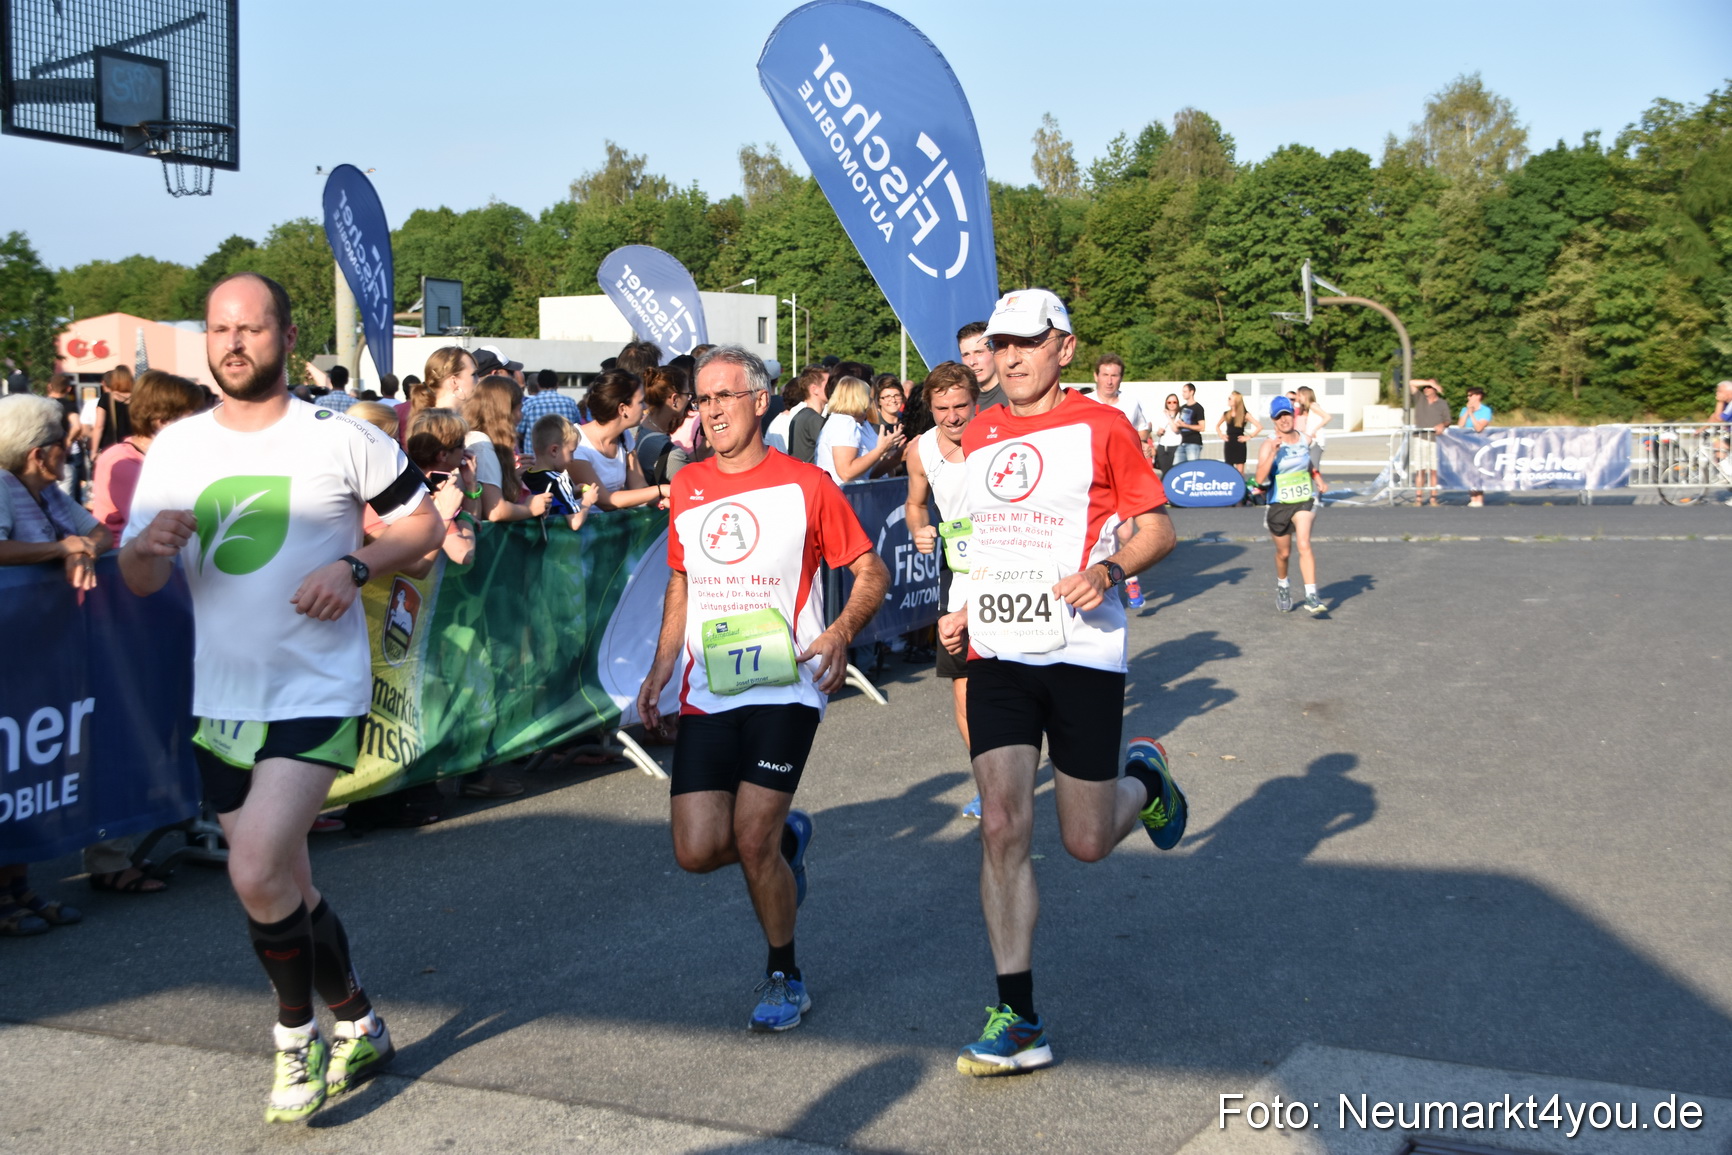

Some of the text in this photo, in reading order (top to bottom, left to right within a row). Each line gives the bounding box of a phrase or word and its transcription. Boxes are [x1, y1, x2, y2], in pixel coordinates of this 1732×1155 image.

[336, 416, 376, 444] Bionorica
[1494, 453, 1588, 471] Fischer
[1503, 472, 1581, 481] AUTOMOBILE
[1183, 480, 1236, 492] Fischer
[1281, 484, 1310, 500] 5195
[1011, 513, 1029, 521] MIT
[1033, 511, 1064, 526] HERZ
[726, 576, 746, 585] MIT
[751, 574, 782, 586] HERZ
[971, 566, 1044, 582] df-sports
[979, 592, 1052, 624] 8924
[727, 644, 763, 676] 77
[757, 759, 787, 773] JAKO
